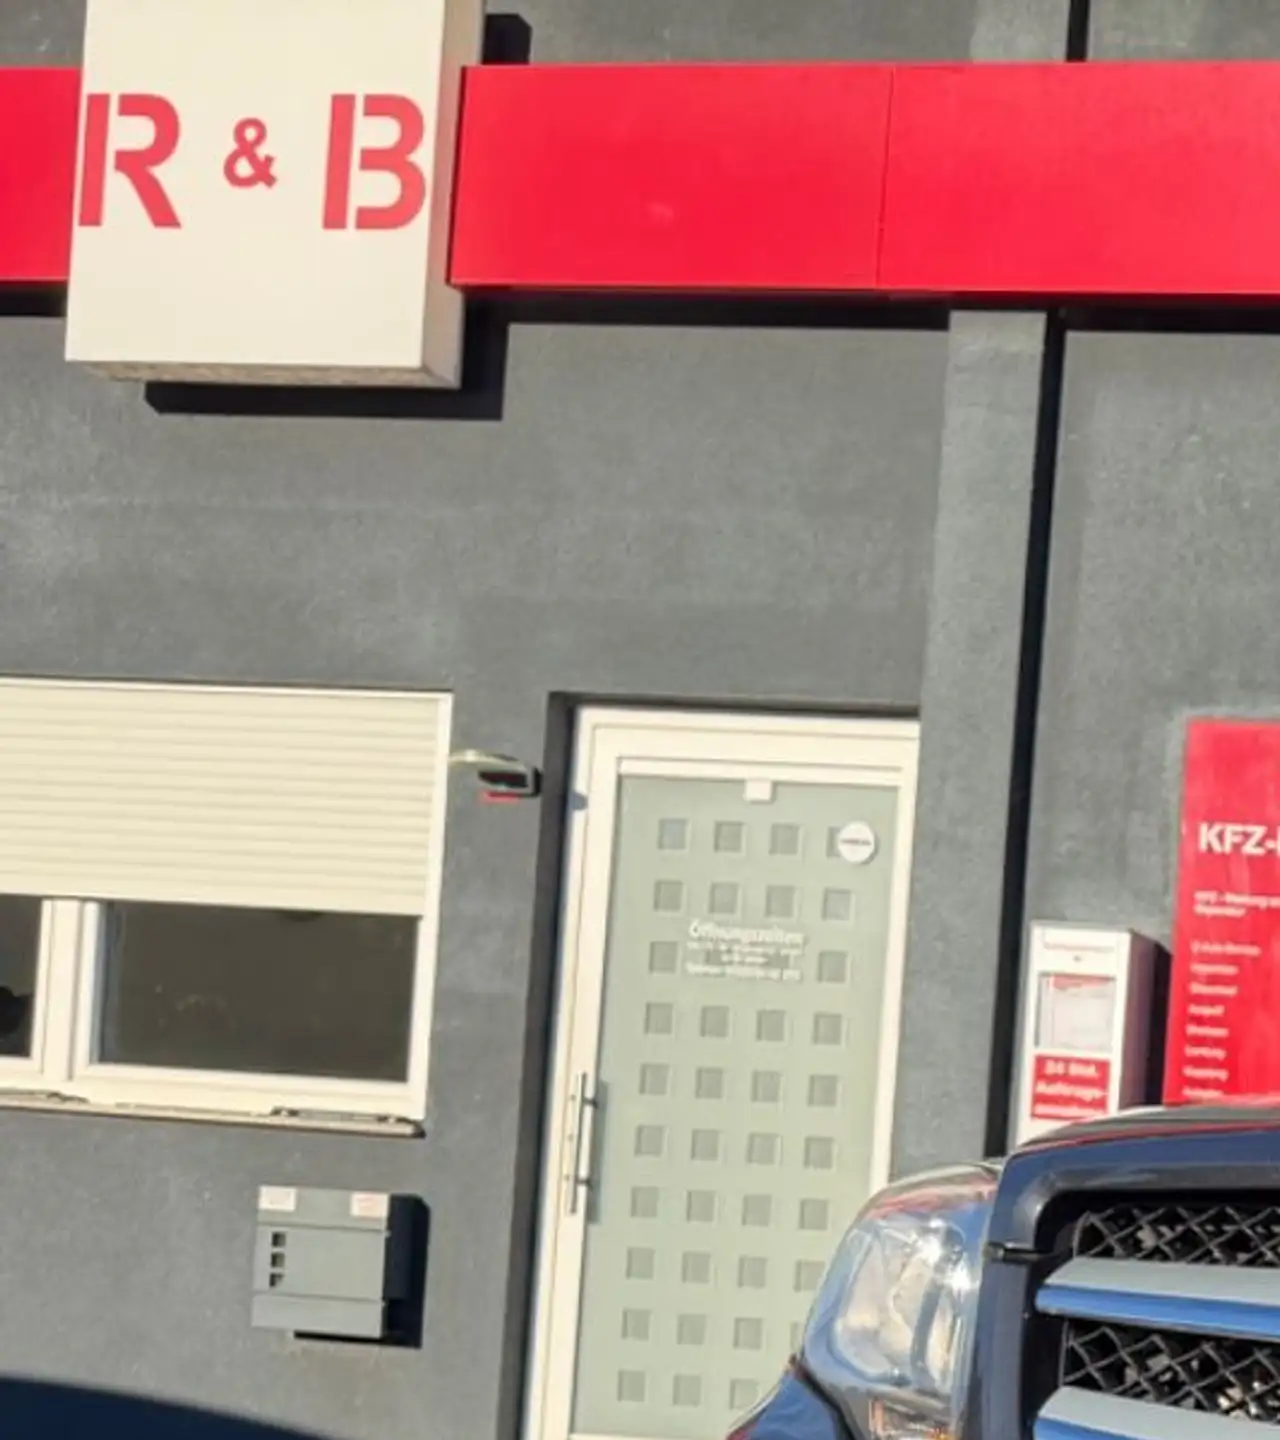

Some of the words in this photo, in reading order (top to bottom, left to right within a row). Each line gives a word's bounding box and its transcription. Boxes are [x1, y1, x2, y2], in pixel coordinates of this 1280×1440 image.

[78, 93, 182, 229] R
[224, 117, 278, 189] &
[322, 93, 427, 230] B
